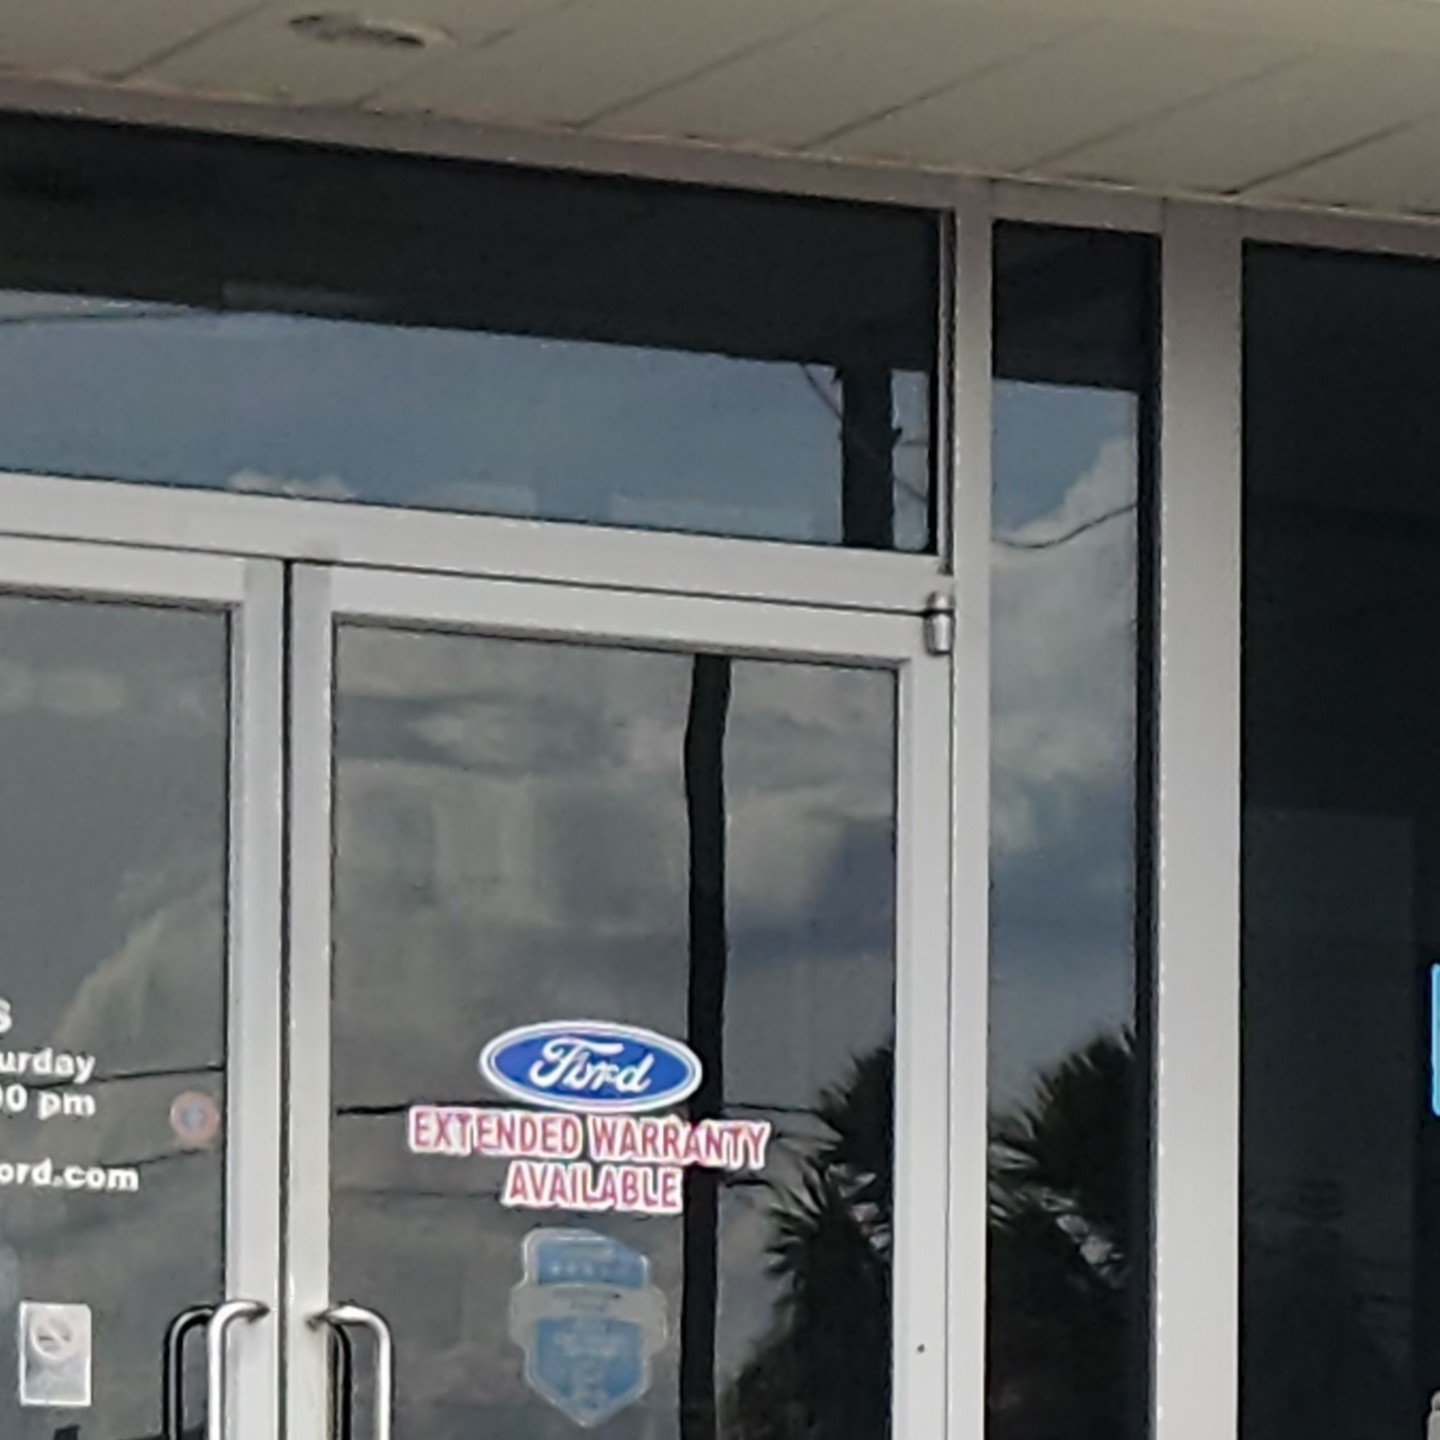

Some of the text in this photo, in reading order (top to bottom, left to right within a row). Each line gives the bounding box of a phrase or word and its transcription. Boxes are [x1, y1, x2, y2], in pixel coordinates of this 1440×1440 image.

[529, 1037, 654, 1093] Ford
[38, 1090, 96, 1120] pm
[411, 1107, 769, 1167] EXTENDED WARRANTY
[504, 1162, 683, 1211] AVAILABLE
